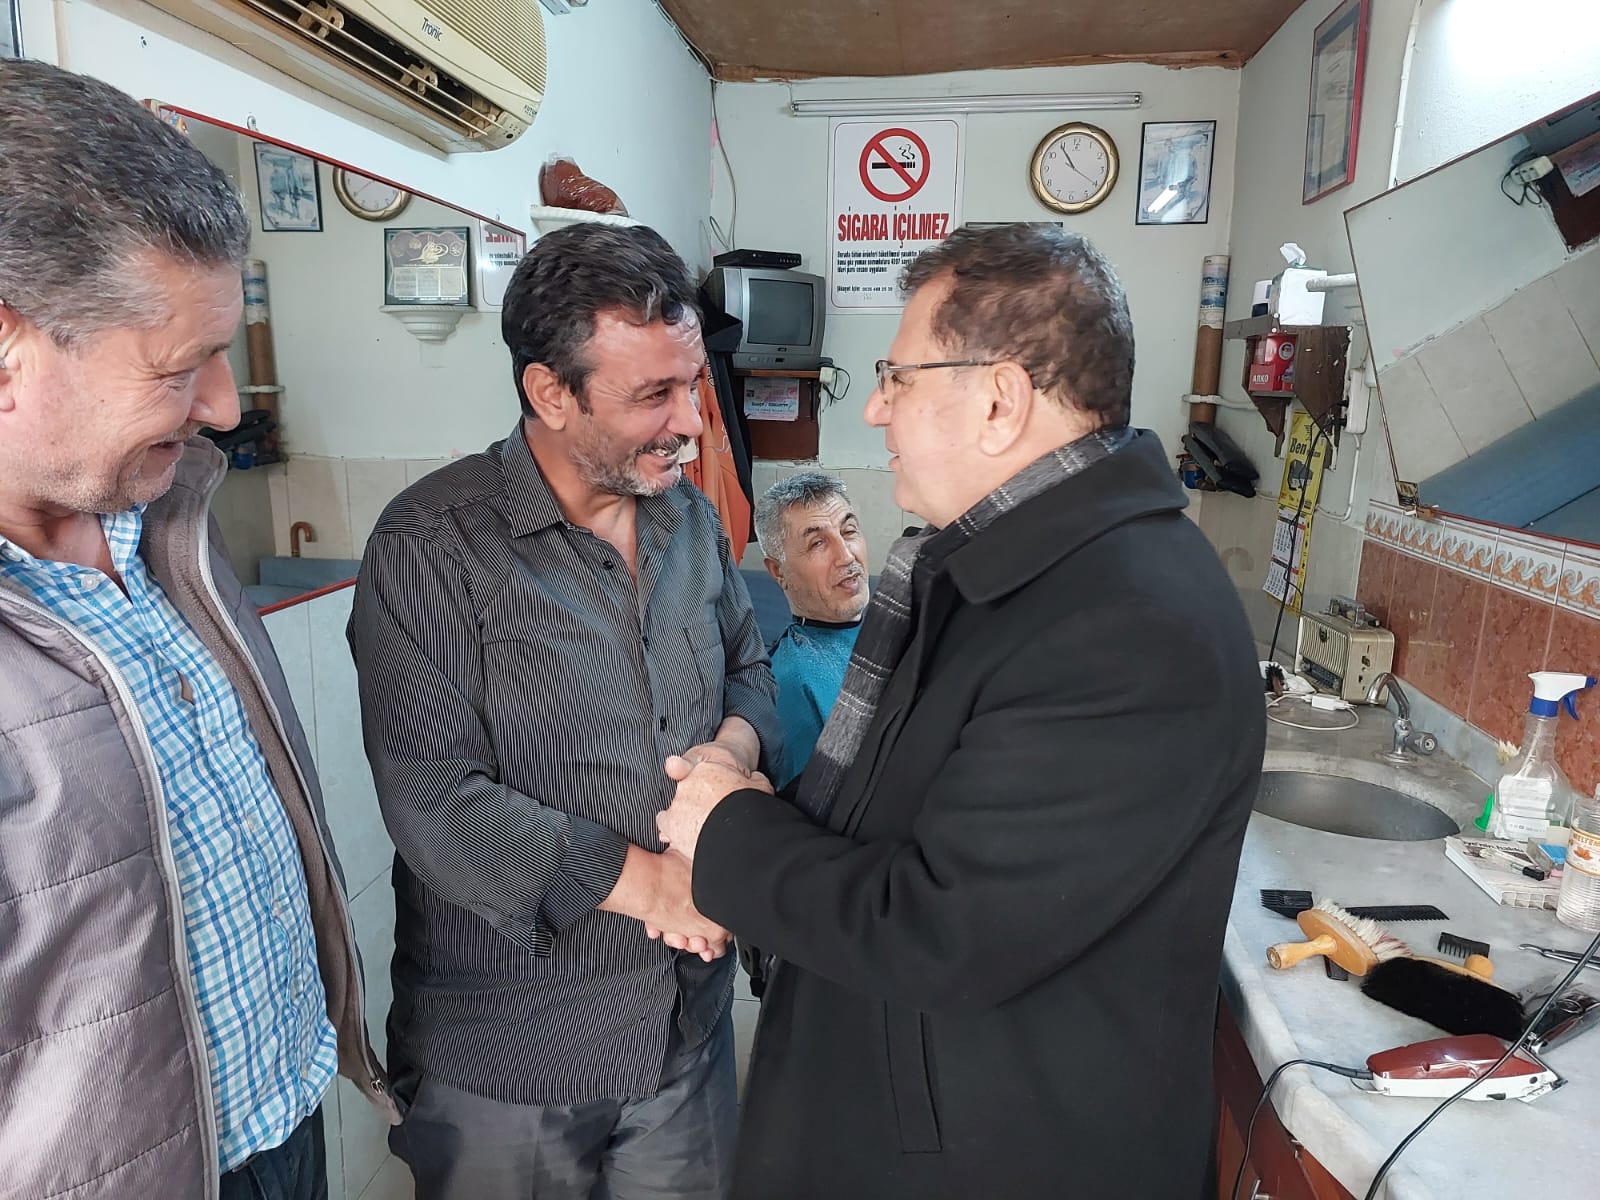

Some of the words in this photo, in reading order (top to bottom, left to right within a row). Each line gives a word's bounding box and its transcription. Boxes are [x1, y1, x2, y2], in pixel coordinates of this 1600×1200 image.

[421, 17, 443, 41] Tronic
[837, 205, 889, 241] SİGARA
[893, 204, 949, 248] İÇİLMEZ
[1253, 374, 1269, 383] ARKO
[1290, 437, 1307, 455] Ben
